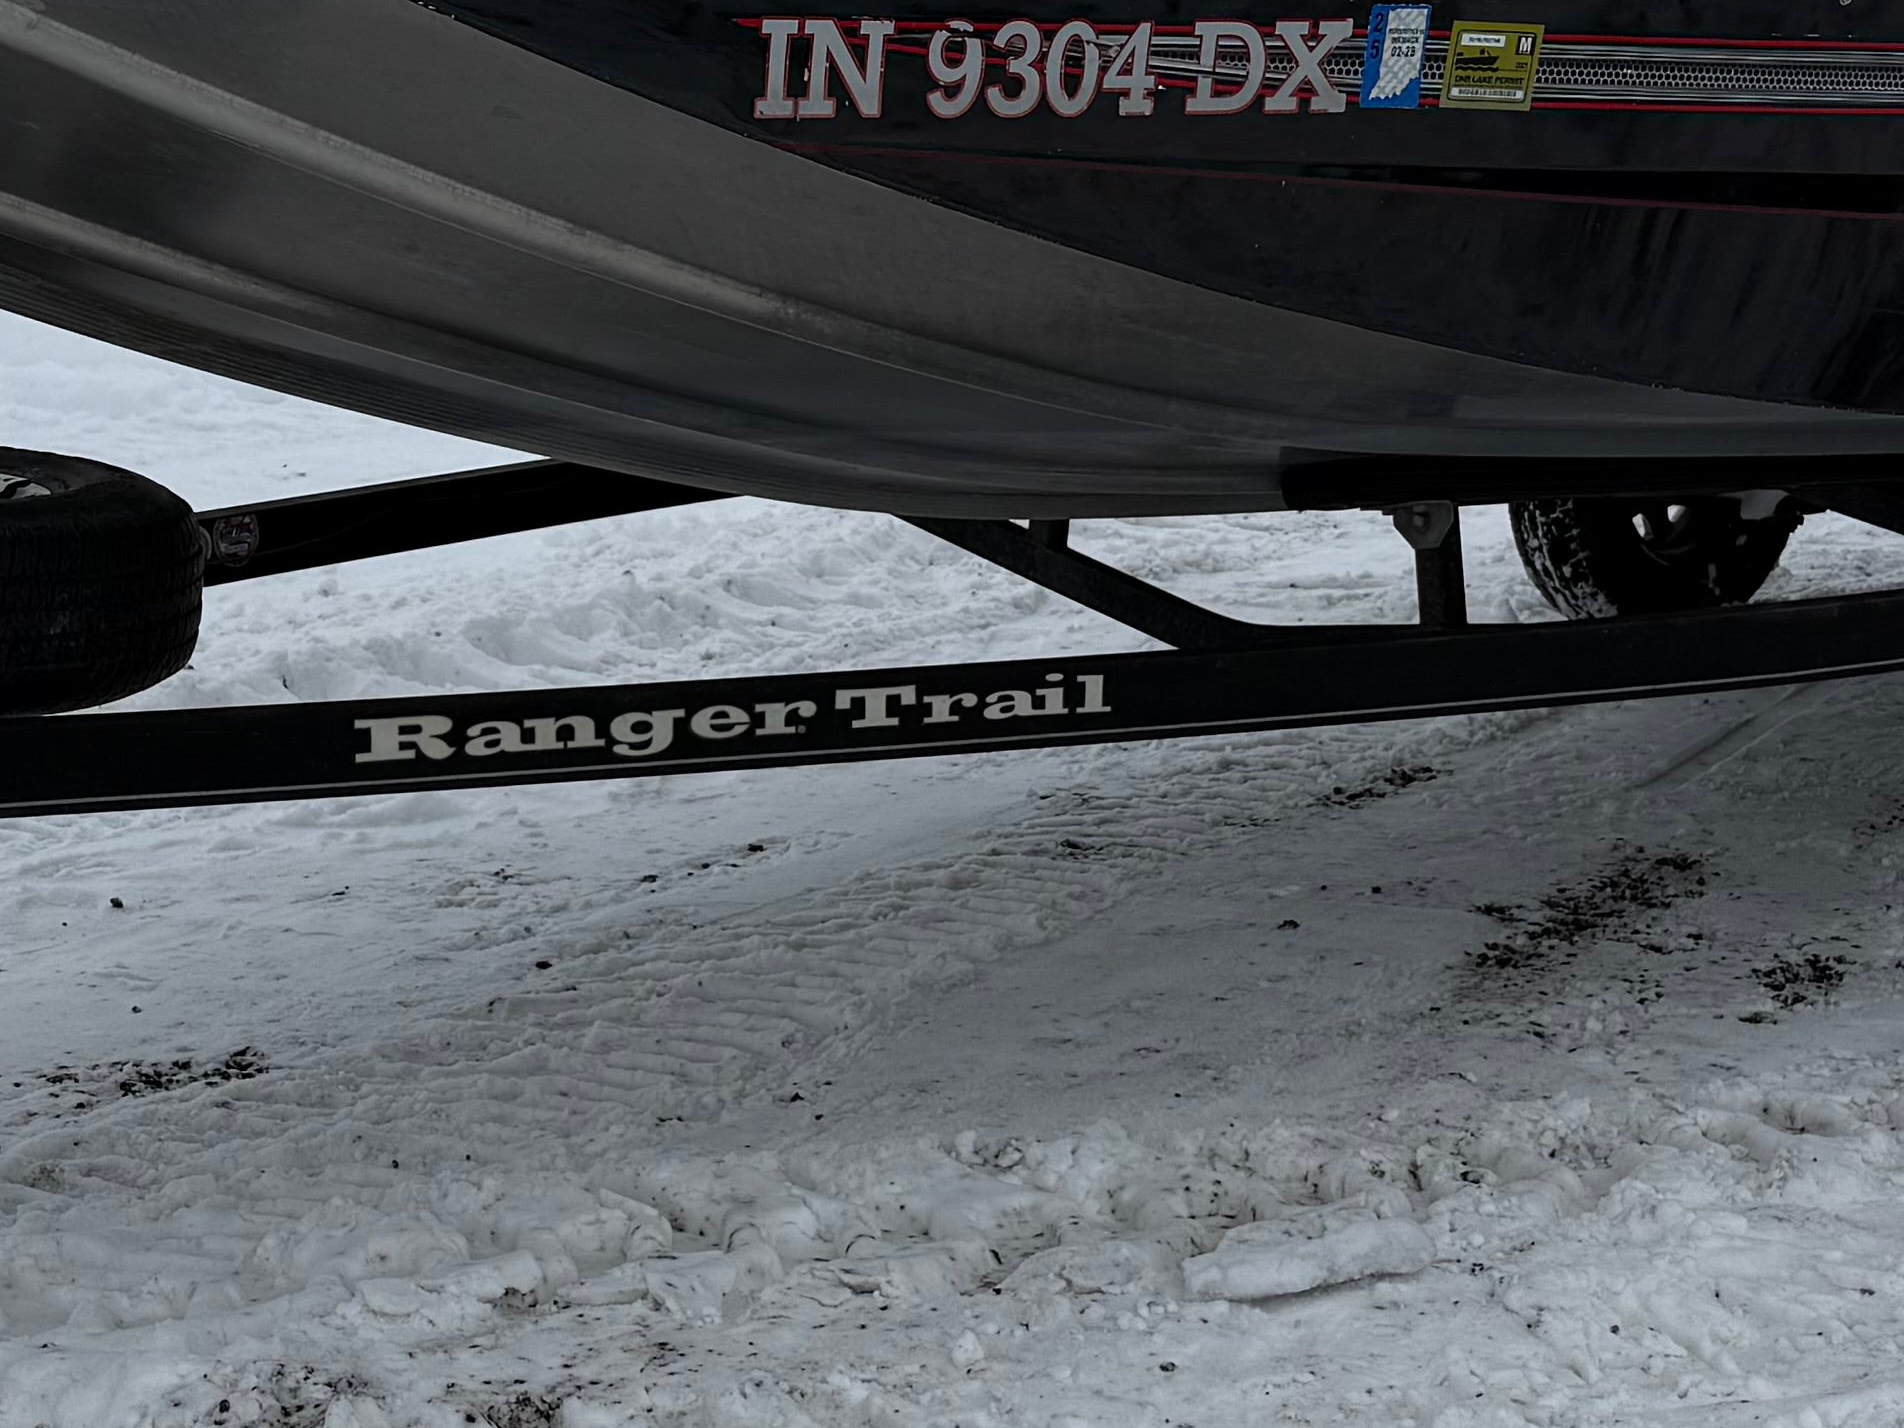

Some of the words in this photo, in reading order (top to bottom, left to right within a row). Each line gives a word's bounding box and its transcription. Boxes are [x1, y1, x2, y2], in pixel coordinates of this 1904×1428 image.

[753, 18, 895, 119] IN
[925, 18, 1159, 119] 9304
[1184, 18, 1355, 115] DX
[353, 699, 817, 764] Ranger
[834, 672, 1113, 729] Trail
